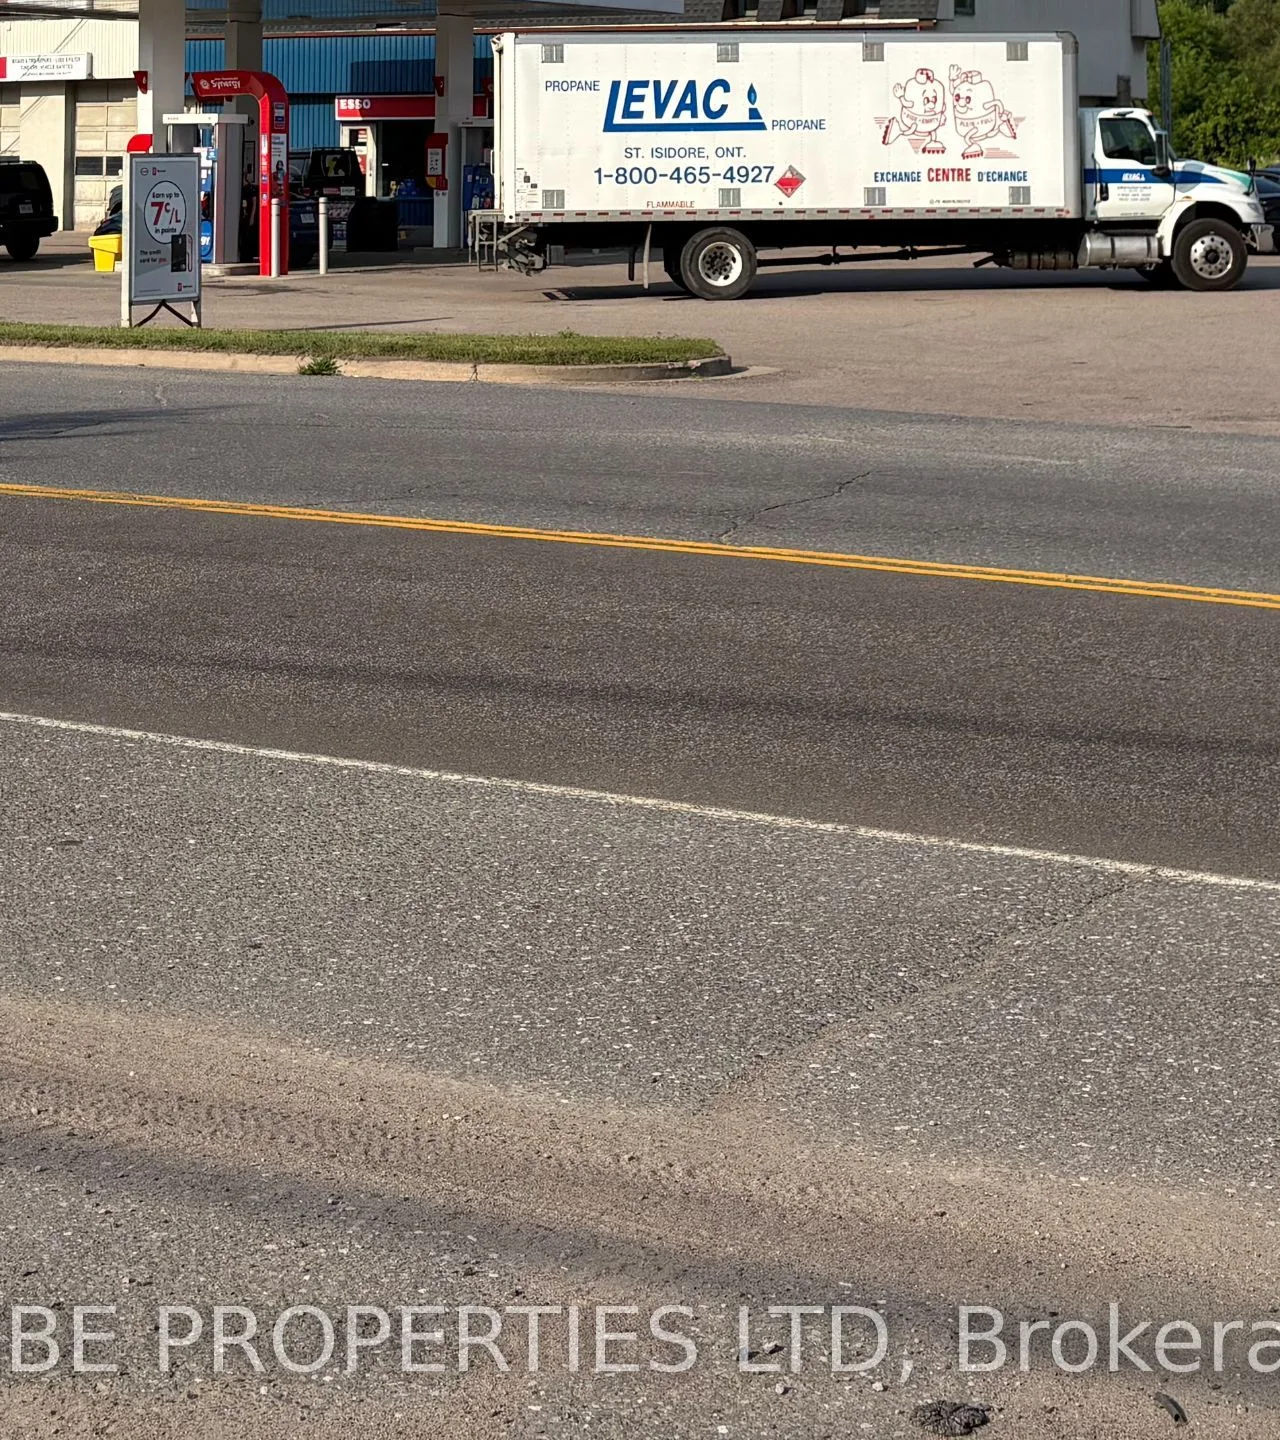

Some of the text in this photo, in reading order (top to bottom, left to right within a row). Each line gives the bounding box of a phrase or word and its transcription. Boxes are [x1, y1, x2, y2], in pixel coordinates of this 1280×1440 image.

[545, 80, 600, 92] PROPANE
[339, 98, 370, 110] ESSO
[603, 79, 767, 132] LEVAC
[771, 119, 826, 131] PROPANE
[624, 146, 747, 160] ST. ISIDORE, ONT.
[593, 166, 775, 185] 1-800-465-4927
[874, 168, 1028, 183] EXCHANGE CENTRE D'ECHANGE
